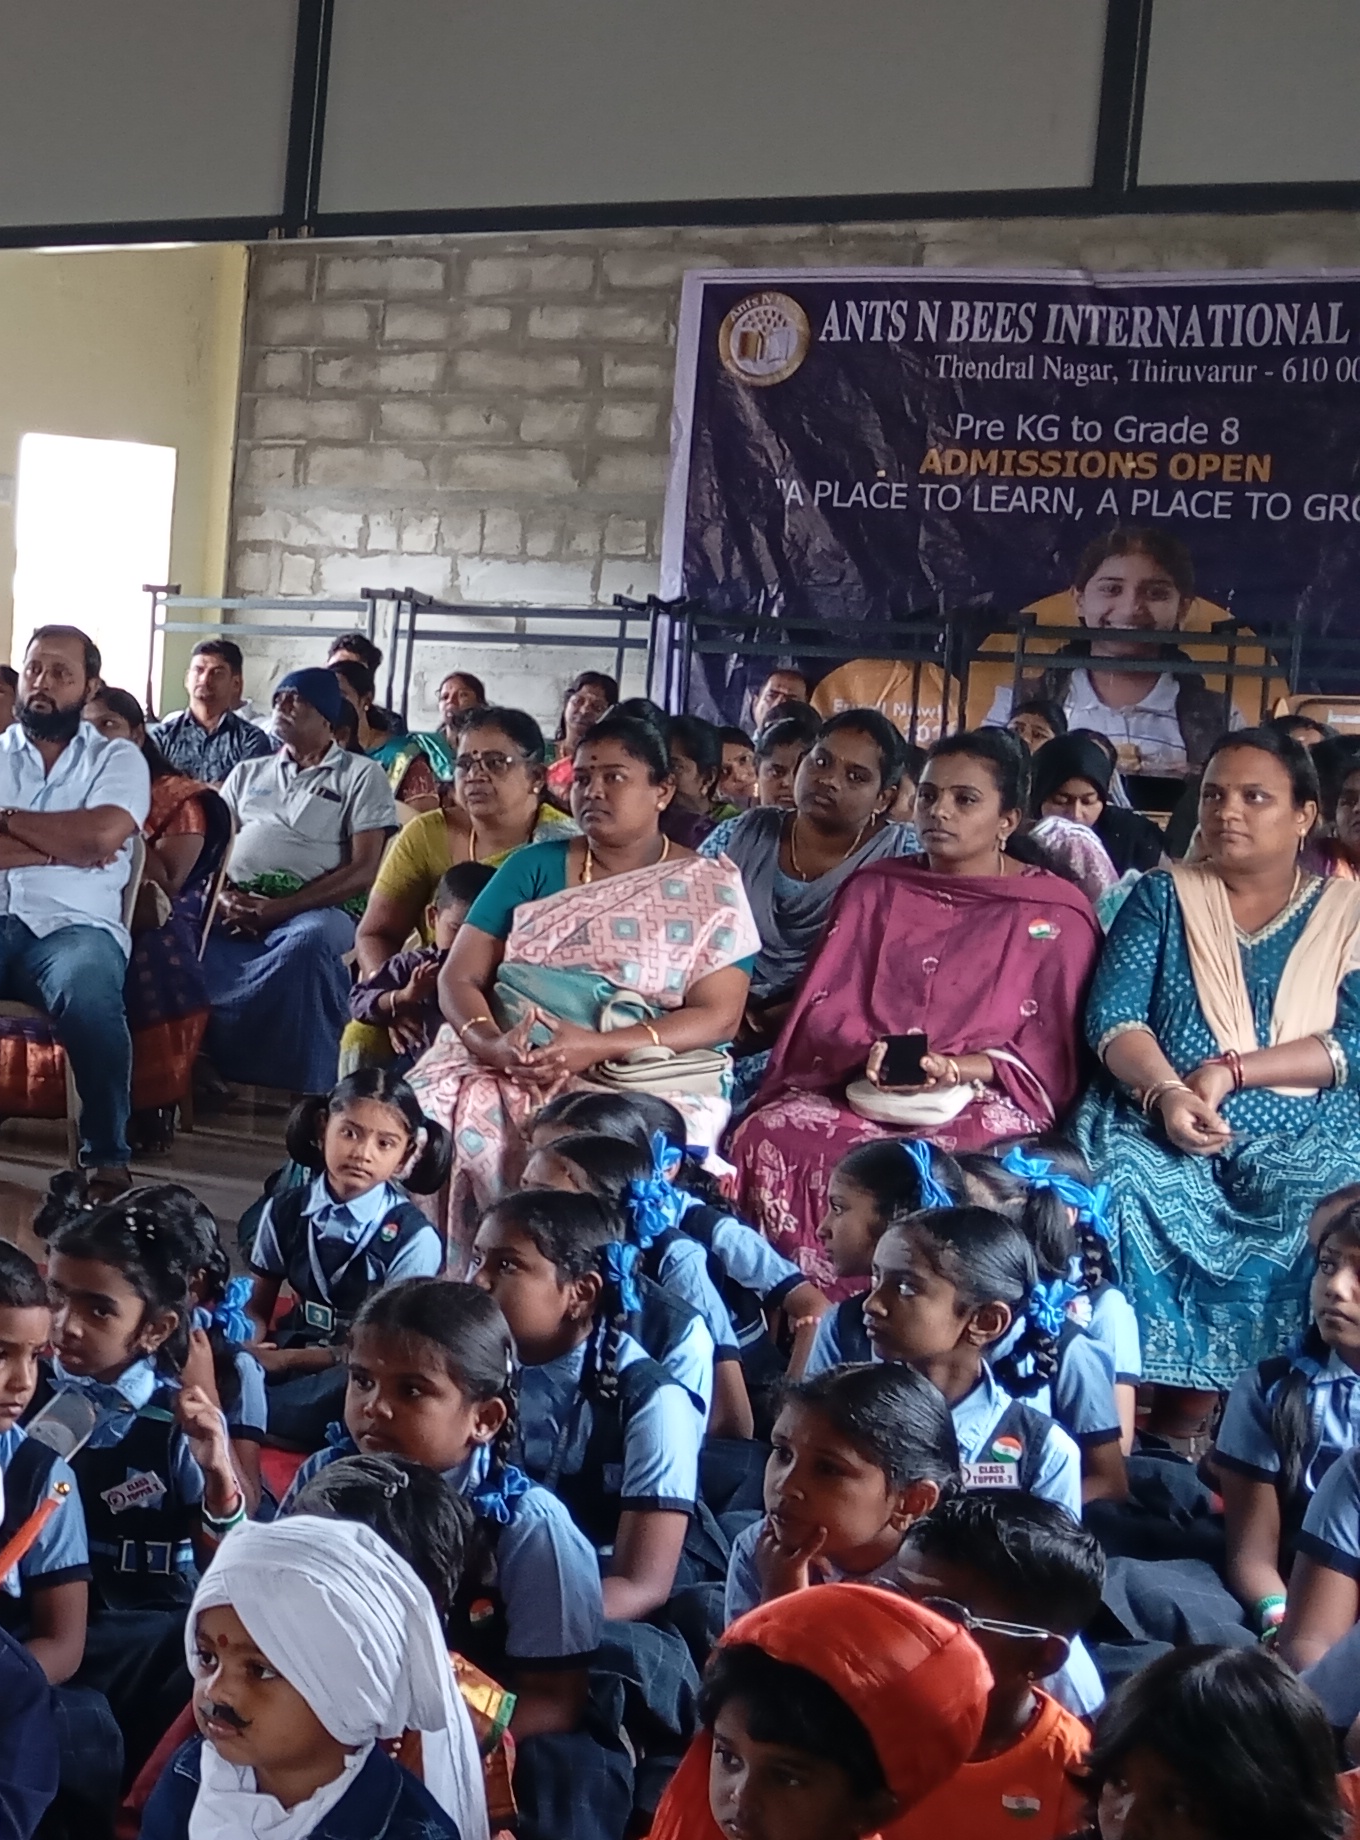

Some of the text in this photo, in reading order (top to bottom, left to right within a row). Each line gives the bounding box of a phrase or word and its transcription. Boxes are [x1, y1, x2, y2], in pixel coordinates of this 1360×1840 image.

[818, 299, 908, 342] ANTS
[914, 300, 942, 343] N
[947, 300, 1037, 343] BEES
[1042, 302, 1351, 348] INTERNATIONAL
[934, 354, 1034, 380] Thendral
[1042, 355, 1119, 387] Nagar,
[1128, 358, 1258, 383] Thiruvarur
[1282, 356, 1328, 382] 610
[954, 412, 1240, 445] Pre KG to Grade 8
[919, 448, 1272, 483] ADMISSIONS OPEN
[813, 480, 909, 510] PLACE
[918, 483, 963, 512] TO
[972, 484, 1084, 521] LEARN,
[1095, 487, 1120, 516] A
[1130, 488, 1234, 519] PLACE
[1244, 491, 1292, 521] TO
